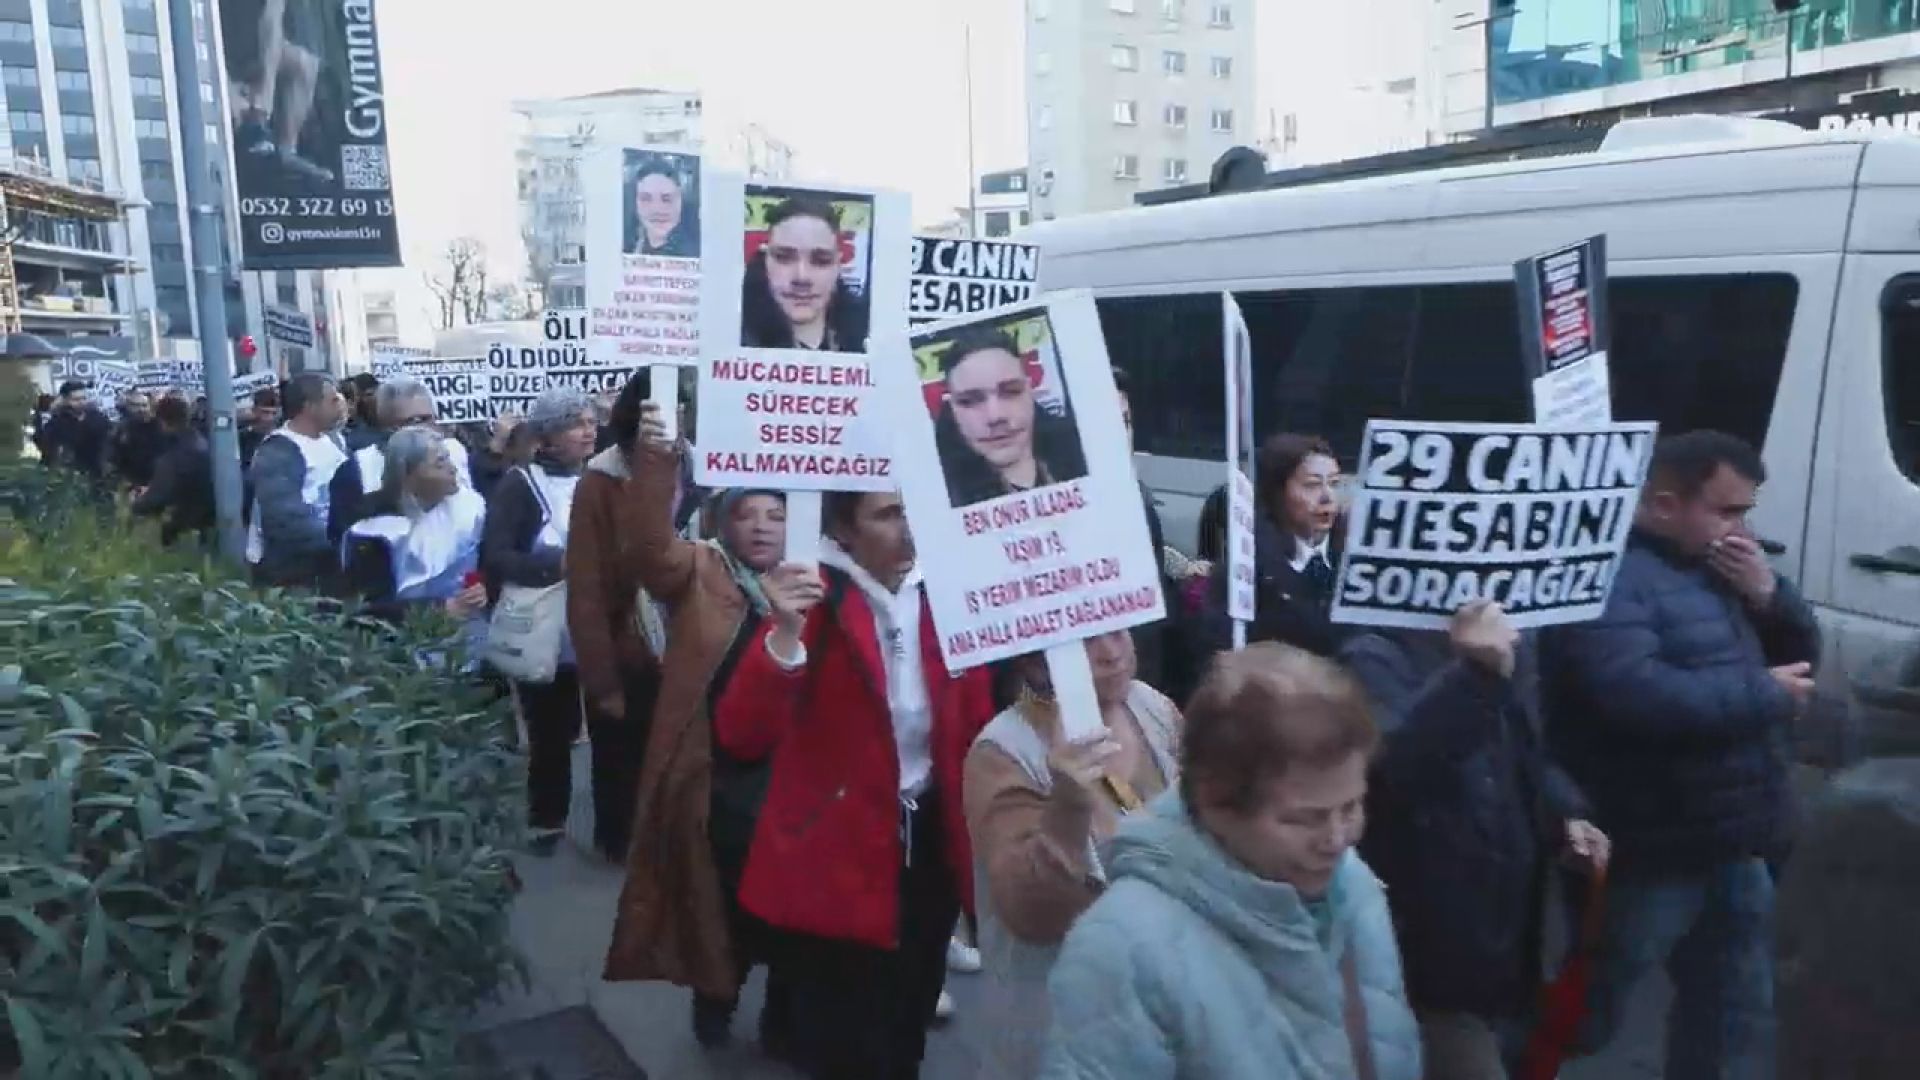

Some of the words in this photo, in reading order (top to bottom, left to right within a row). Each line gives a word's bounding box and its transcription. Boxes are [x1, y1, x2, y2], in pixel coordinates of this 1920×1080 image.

[242, 198, 291, 217] 0532
[298, 198, 336, 217] 322
[341, 198, 367, 217] 69
[933, 241, 1036, 280] CANIN
[746, 389, 859, 417] SÜRECEK
[760, 421, 843, 445] SESSİZ
[706, 451, 892, 477] KALMAYACAĞIZ
[1366, 431, 1453, 490] 29
[1466, 432, 1648, 492] CANIN
[1361, 498, 1624, 552] HESABINI
[1344, 558, 1609, 611] SORACAĞIZ!
